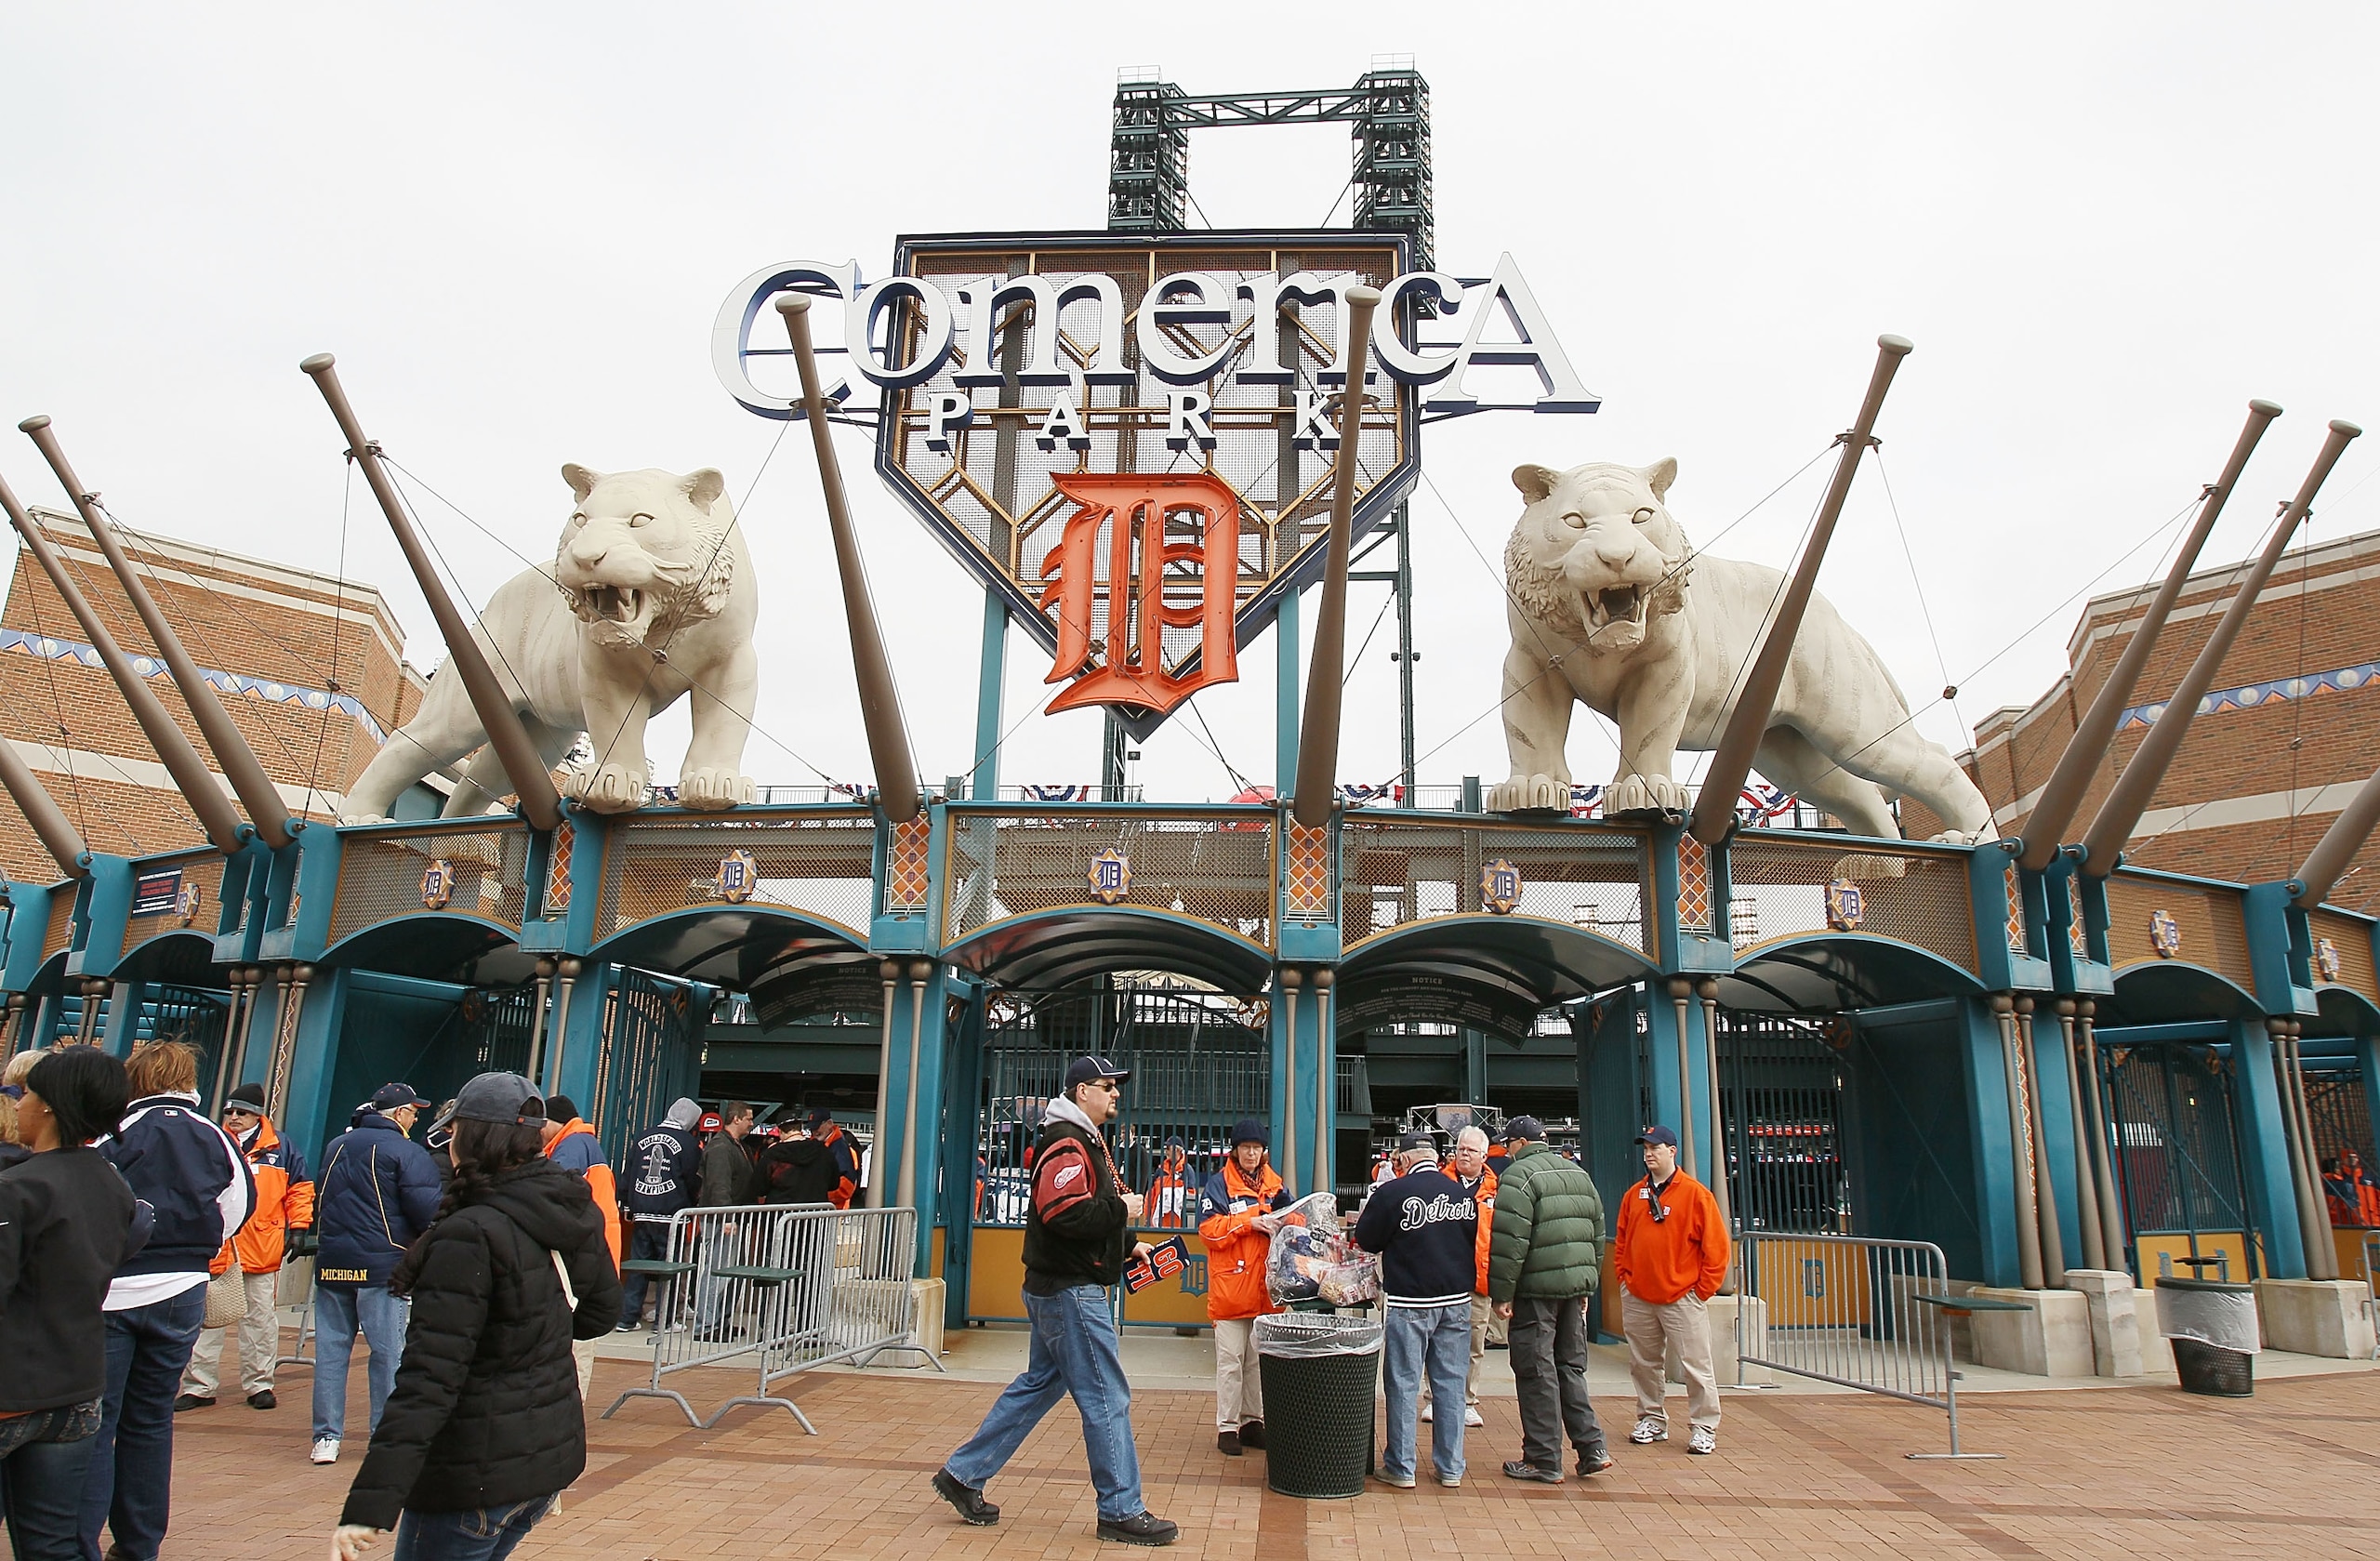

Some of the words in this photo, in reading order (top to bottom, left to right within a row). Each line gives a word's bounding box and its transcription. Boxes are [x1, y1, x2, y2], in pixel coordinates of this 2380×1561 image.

[924, 389, 1341, 451] PARK
[1411, 976, 1443, 985] NOTICE
[639, 1135, 661, 1148] WORLD
[662, 1135, 681, 1152] SERIES
[1400, 1194, 1476, 1231] Detroit
[320, 1267, 368, 1281] MICHIGAN
